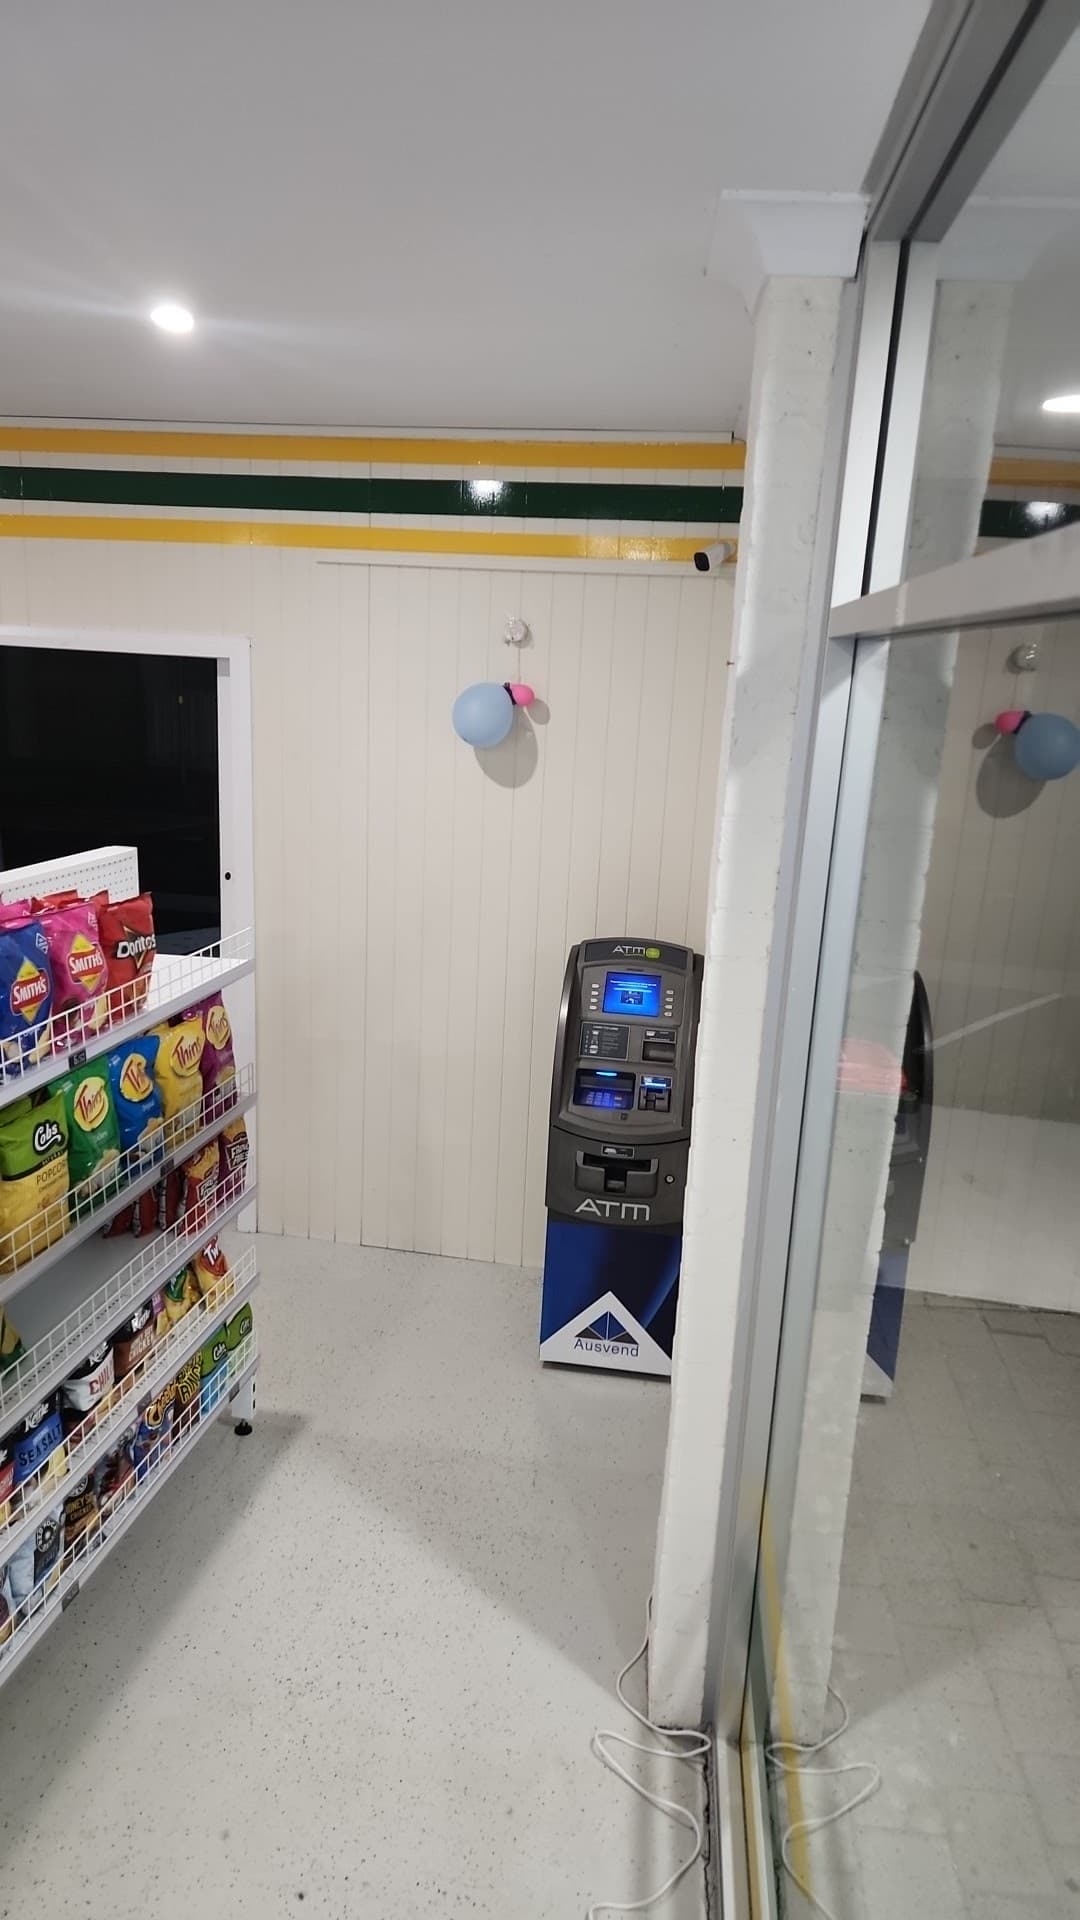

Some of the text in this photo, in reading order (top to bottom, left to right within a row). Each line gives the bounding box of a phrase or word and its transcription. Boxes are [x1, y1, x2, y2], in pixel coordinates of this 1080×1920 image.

[116, 934, 156, 958] Doritos
[612, 945, 645, 955] ATM
[68, 950, 103, 974] SMITH'S
[13, 976, 47, 1005] SMITH'S
[34, 1122, 62, 1151] Cobs
[574, 1198, 650, 1221] ATM
[573, 1338, 639, 1358] Ausvend
